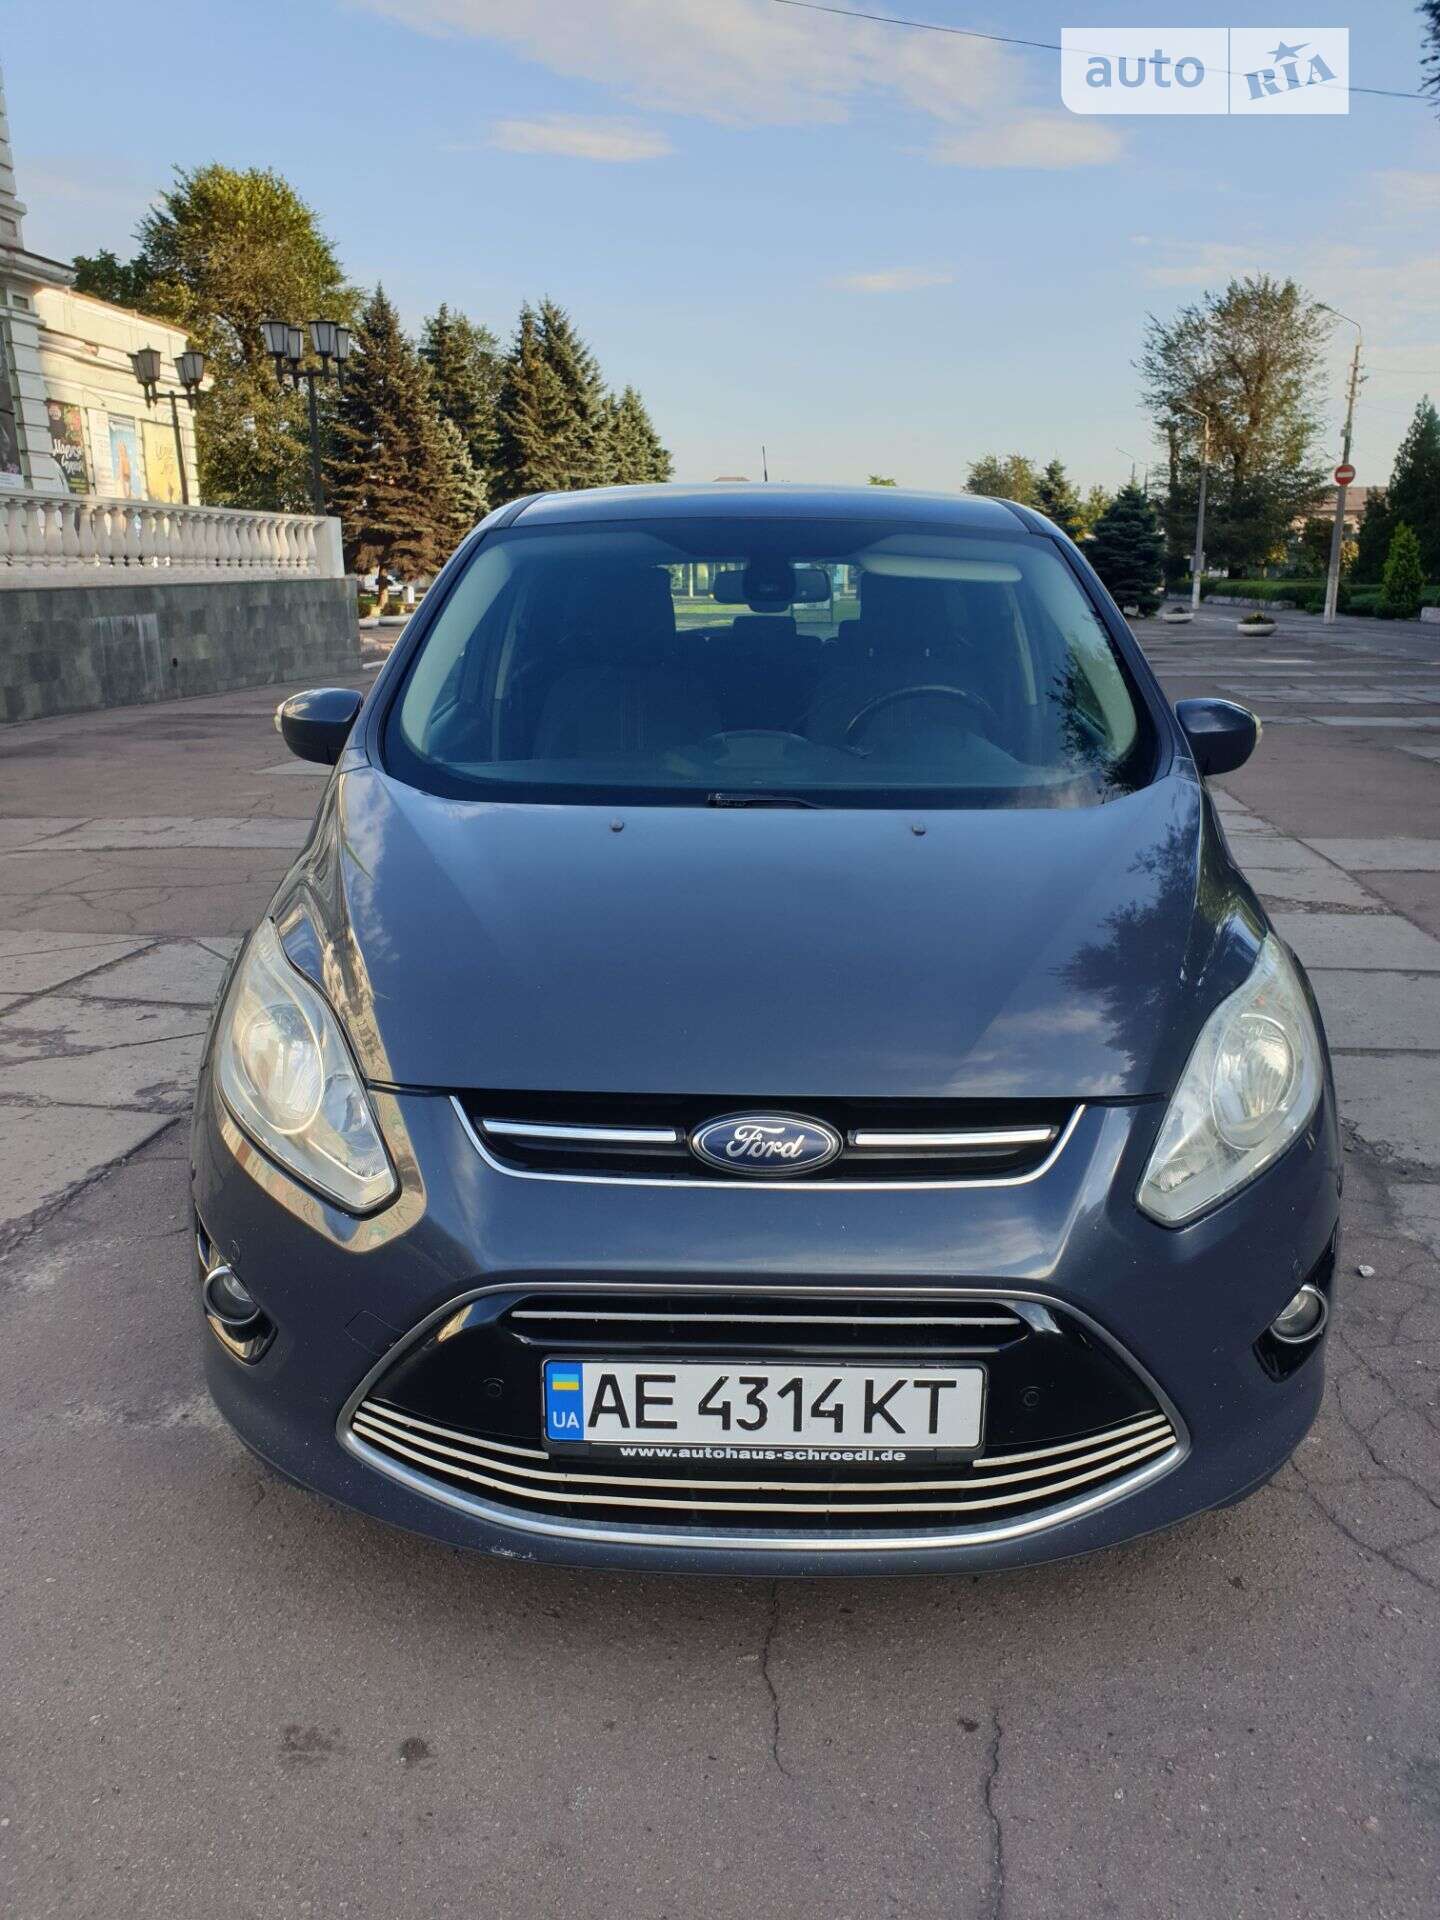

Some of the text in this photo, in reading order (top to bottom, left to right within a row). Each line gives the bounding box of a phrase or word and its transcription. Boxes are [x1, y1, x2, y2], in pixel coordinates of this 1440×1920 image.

[726, 1125, 804, 1158] Ford
[588, 1373, 958, 1434] AE 4314 KT
[552, 1411, 580, 1428] UA
[620, 1447, 907, 1461] www.autohaus-schroedl.de
